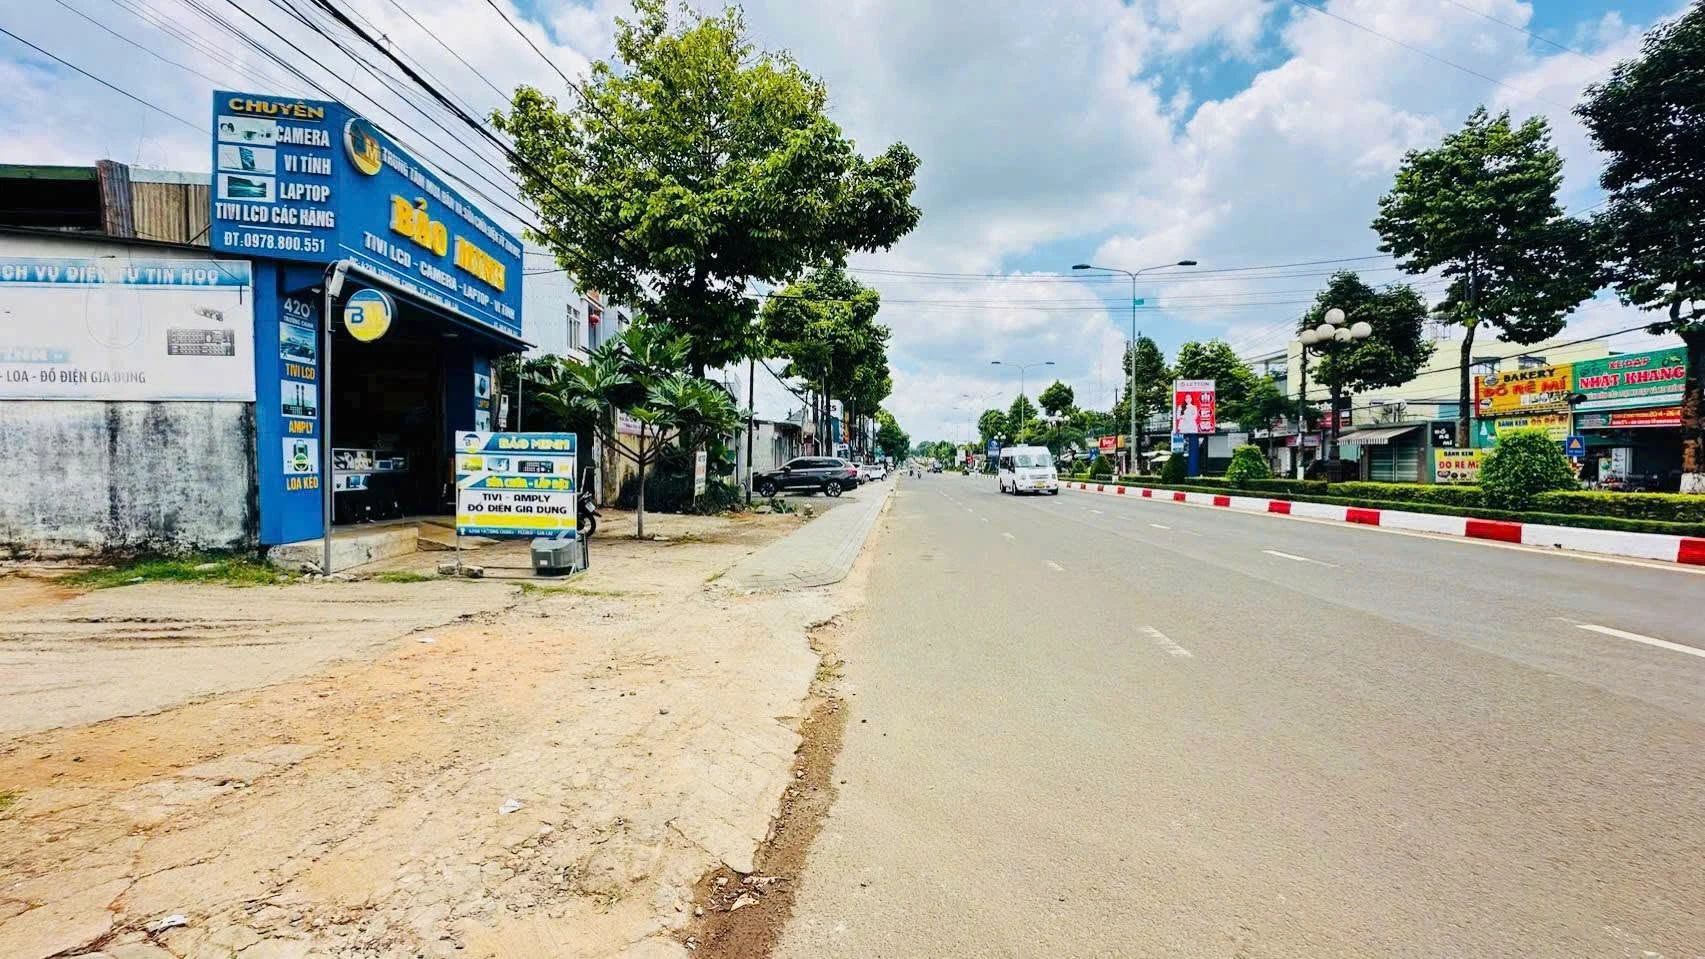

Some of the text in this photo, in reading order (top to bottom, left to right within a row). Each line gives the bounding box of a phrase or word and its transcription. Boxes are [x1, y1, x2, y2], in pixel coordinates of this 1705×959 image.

[228, 97, 324, 119] CHUYÊN
[276, 126, 330, 147] CAMERA
[284, 153, 332, 176] VI TÍNH
[280, 182, 330, 202] LAPTOP
[216, 202, 241, 221] TIVI
[244, 205, 269, 223] LCD
[272, 204, 298, 225] CÁC
[390, 197, 448, 257] BẢO
[224, 231, 326, 253] ĐT:0978.800.551
[0, 264, 28, 281] CH
[146, 268, 174, 283] TIN
[364, 231, 388, 256] TIVI
[389, 244, 412, 268] LCD
[419, 260, 458, 292] CAMERA
[463, 282, 490, 307] LAPTOP
[6, 370, 28, 382] LOA
[60, 369, 87, 385] ĐIỆN
[91, 371, 110, 383] GIA
[286, 363, 316, 380] TIVI LCD
[1504, 368, 1556, 383] BAKERY
[1580, 365, 1685, 390] NHẬT KHANG
[288, 420, 314, 434] AMPLY
[498, 436, 530, 450] BẢO
[286, 475, 319, 491] LOA KÉO
[482, 493, 502, 501] TIVI
[514, 494, 551, 502] AMPLY
[515, 505, 533, 514] GIA
